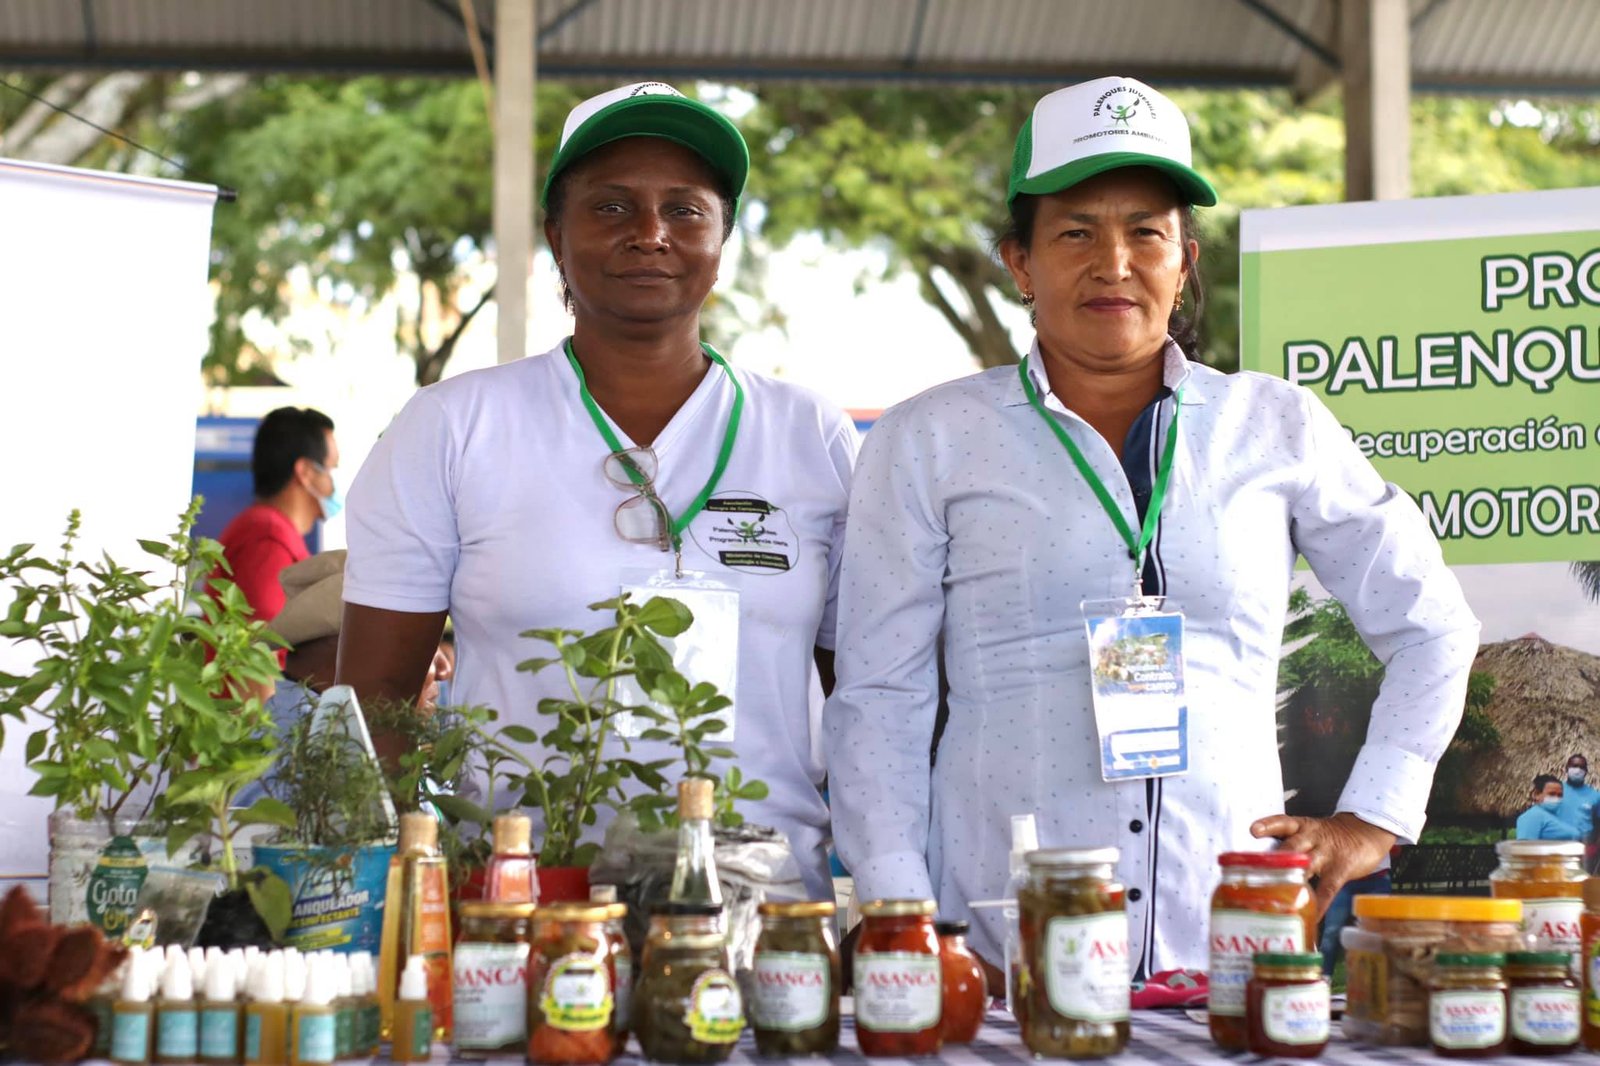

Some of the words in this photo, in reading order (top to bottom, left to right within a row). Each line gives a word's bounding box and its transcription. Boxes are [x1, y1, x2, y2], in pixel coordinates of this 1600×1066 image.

[1093, 86, 1127, 117] PALENQUES
[1072, 129, 1129, 145] PROMOTORES
[1284, 326, 1600, 394] PALENQU
[1339, 414, 1587, 462] ecuperación
[1406, 484, 1600, 539] MOTOR
[92, 880, 138, 914] Gota
